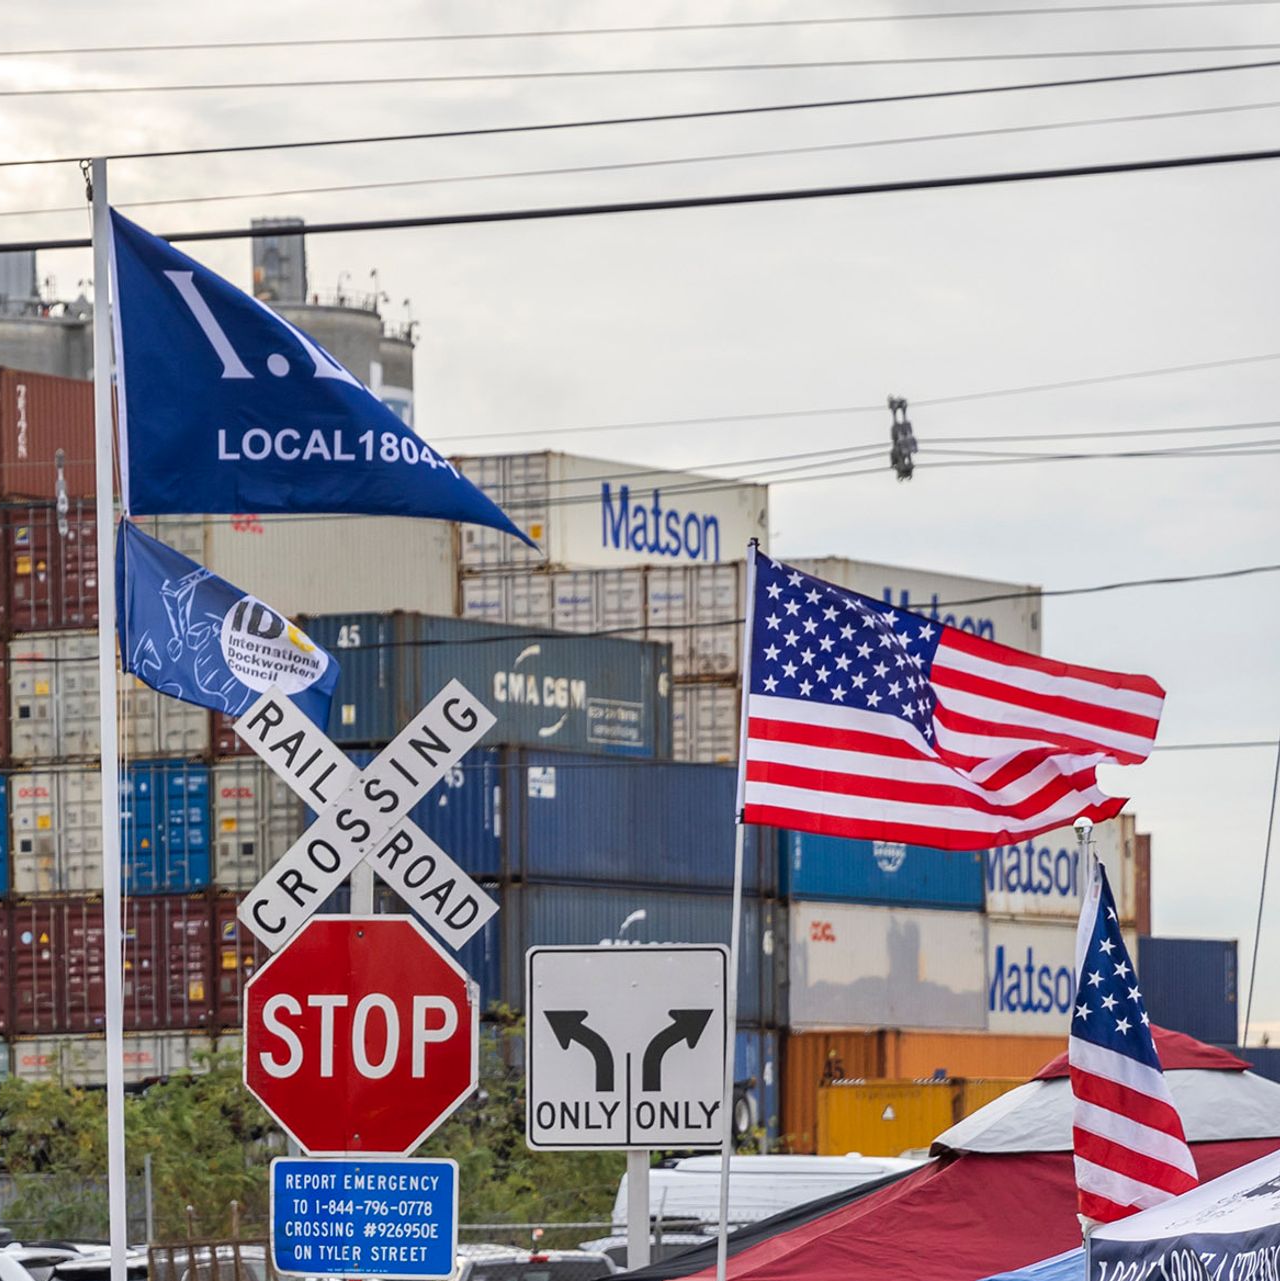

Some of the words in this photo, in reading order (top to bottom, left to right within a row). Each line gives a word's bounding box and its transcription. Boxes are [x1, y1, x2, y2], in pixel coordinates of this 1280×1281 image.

[218, 427, 356, 462] LOCAL
[601, 483, 720, 563] Matson
[228, 636, 321, 669] International
[337, 625, 360, 648] 45
[227, 648, 317, 680] Dockworkers
[227, 659, 278, 682] Council
[493, 670, 540, 706] CMA
[247, 700, 338, 804] RAIL
[252, 697, 478, 935] CROSSING
[377, 829, 479, 931] ROAD
[260, 993, 460, 1079] STOP
[536, 1101, 621, 1130] ONLY
[636, 1101, 721, 1130] ONLY
[285, 1174, 337, 1190] REPORT
[343, 1175, 439, 1191] EMERGENCY
[293, 1199, 309, 1215] TO
[315, 1199, 433, 1216] 1-844-796-0778
[285, 1221, 355, 1238] CROSSING
[362, 1223, 439, 1239] #926950E
[294, 1244, 313, 1260] ON
[318, 1245, 361, 1261] TYLER
[370, 1246, 428, 1262] STREET
